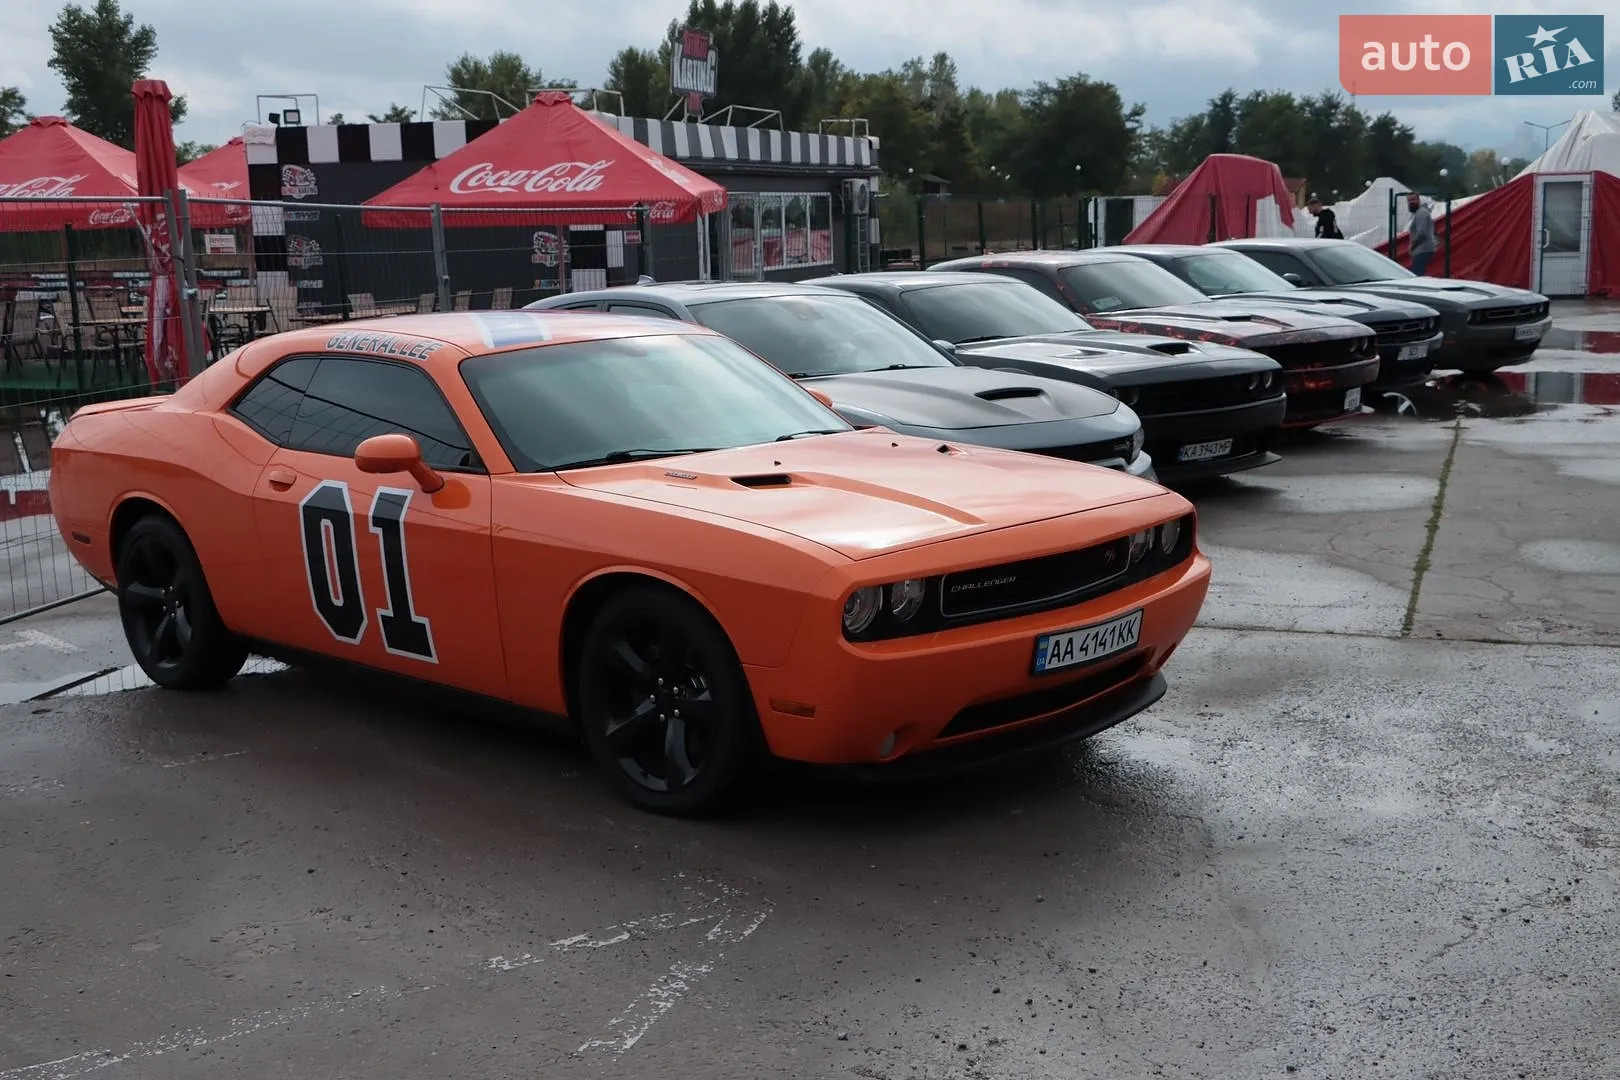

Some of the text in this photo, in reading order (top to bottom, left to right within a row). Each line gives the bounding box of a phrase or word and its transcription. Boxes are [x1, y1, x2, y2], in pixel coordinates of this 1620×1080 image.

[449, 159, 616, 194] Coca-Cola
[299, 479, 439, 664] 01
[950, 576, 1017, 593] CHALLENGER
[1047, 637, 1074, 665] AA
